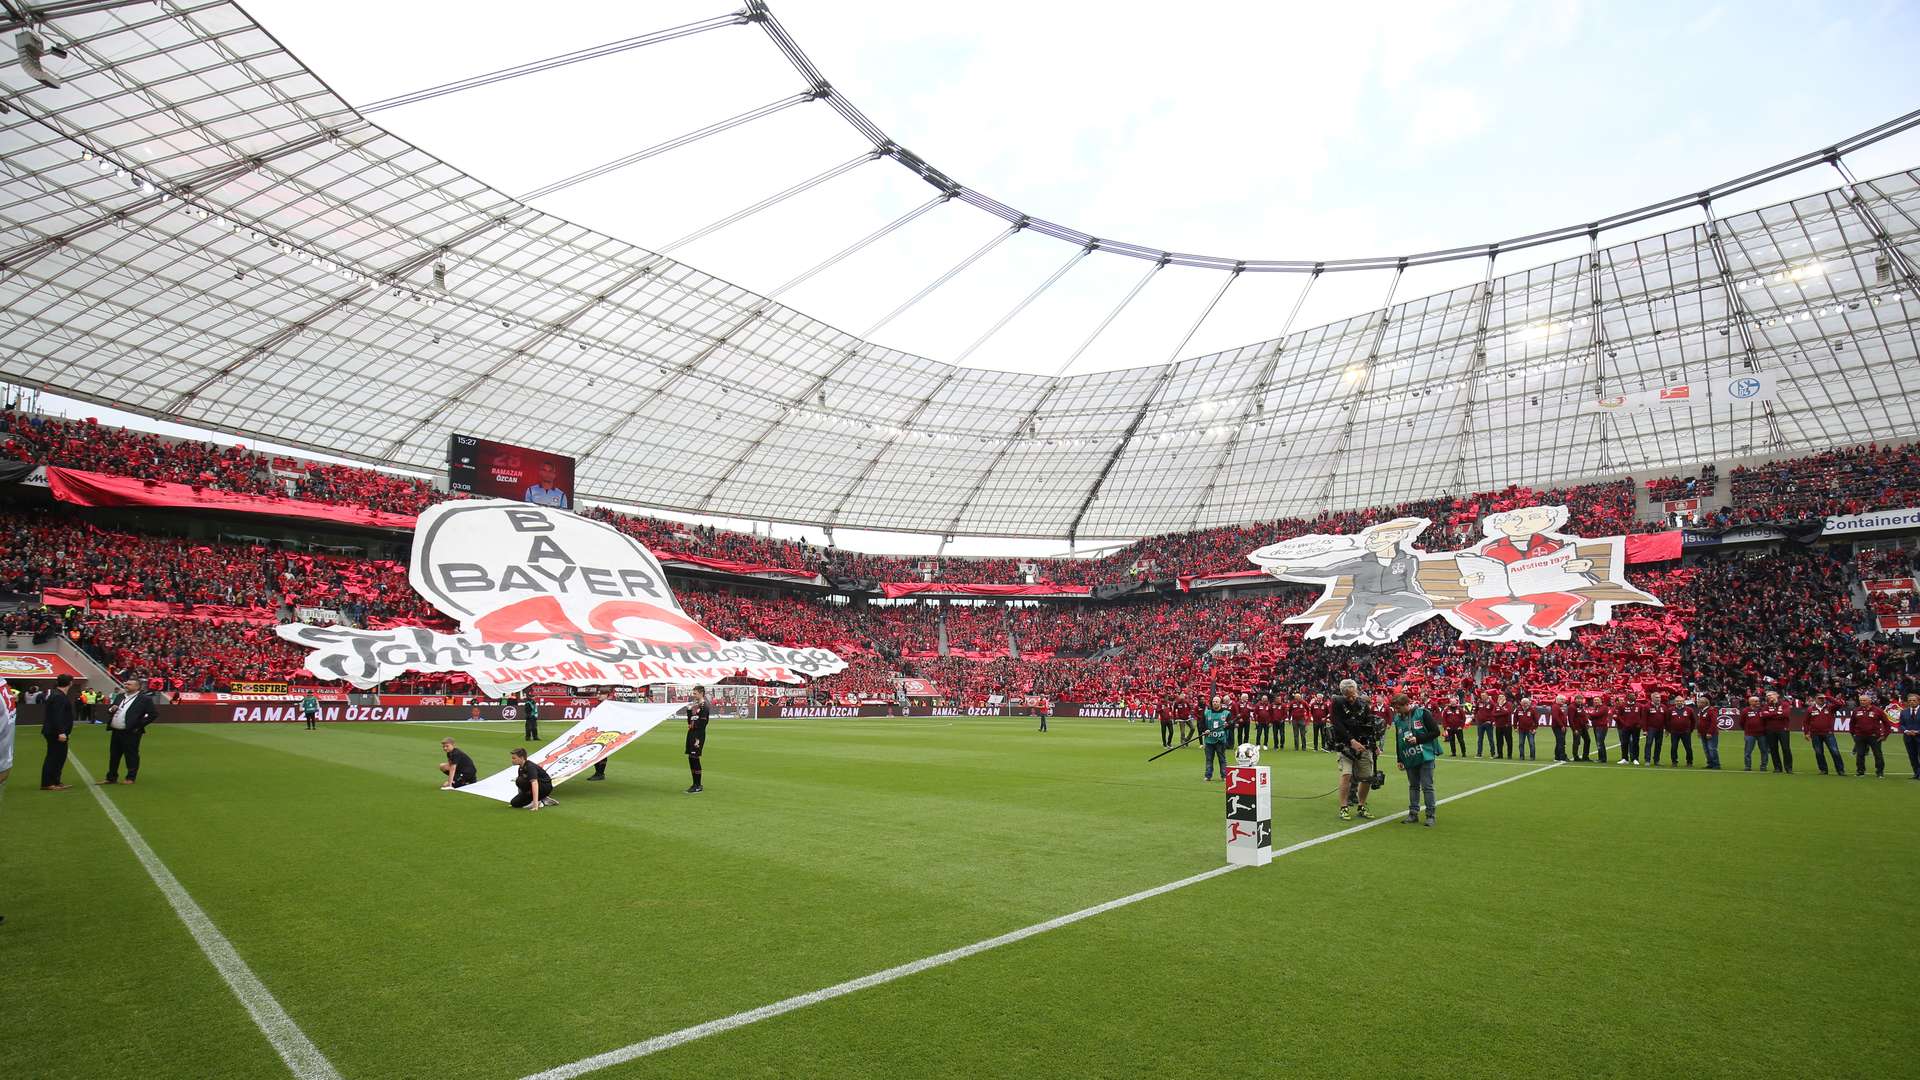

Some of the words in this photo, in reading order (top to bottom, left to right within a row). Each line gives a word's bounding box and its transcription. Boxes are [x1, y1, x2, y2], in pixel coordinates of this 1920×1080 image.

[458, 436, 476, 446] 15:27
[491, 467, 523, 477] RAMAZAN
[496, 474, 518, 483] ÖZCAN
[1510, 560, 1549, 573] Aufstieg
[1550, 555, 1571, 566] 1979
[438, 563, 662, 598] BAYER
[298, 627, 541, 679] Jahre
[549, 632, 838, 673] Bundesliga
[482, 660, 608, 684] UNTERM
[233, 706, 340, 722] RAMAAN
[346, 704, 410, 721] ÖZCAN
[780, 708, 829, 717] RAMAZAN
[829, 705, 859, 717] ÖZCAN
[968, 706, 1000, 716] ÖZCAN
[1078, 708, 1123, 718] RAMAZAN
[1718, 718, 1732, 726] 28
